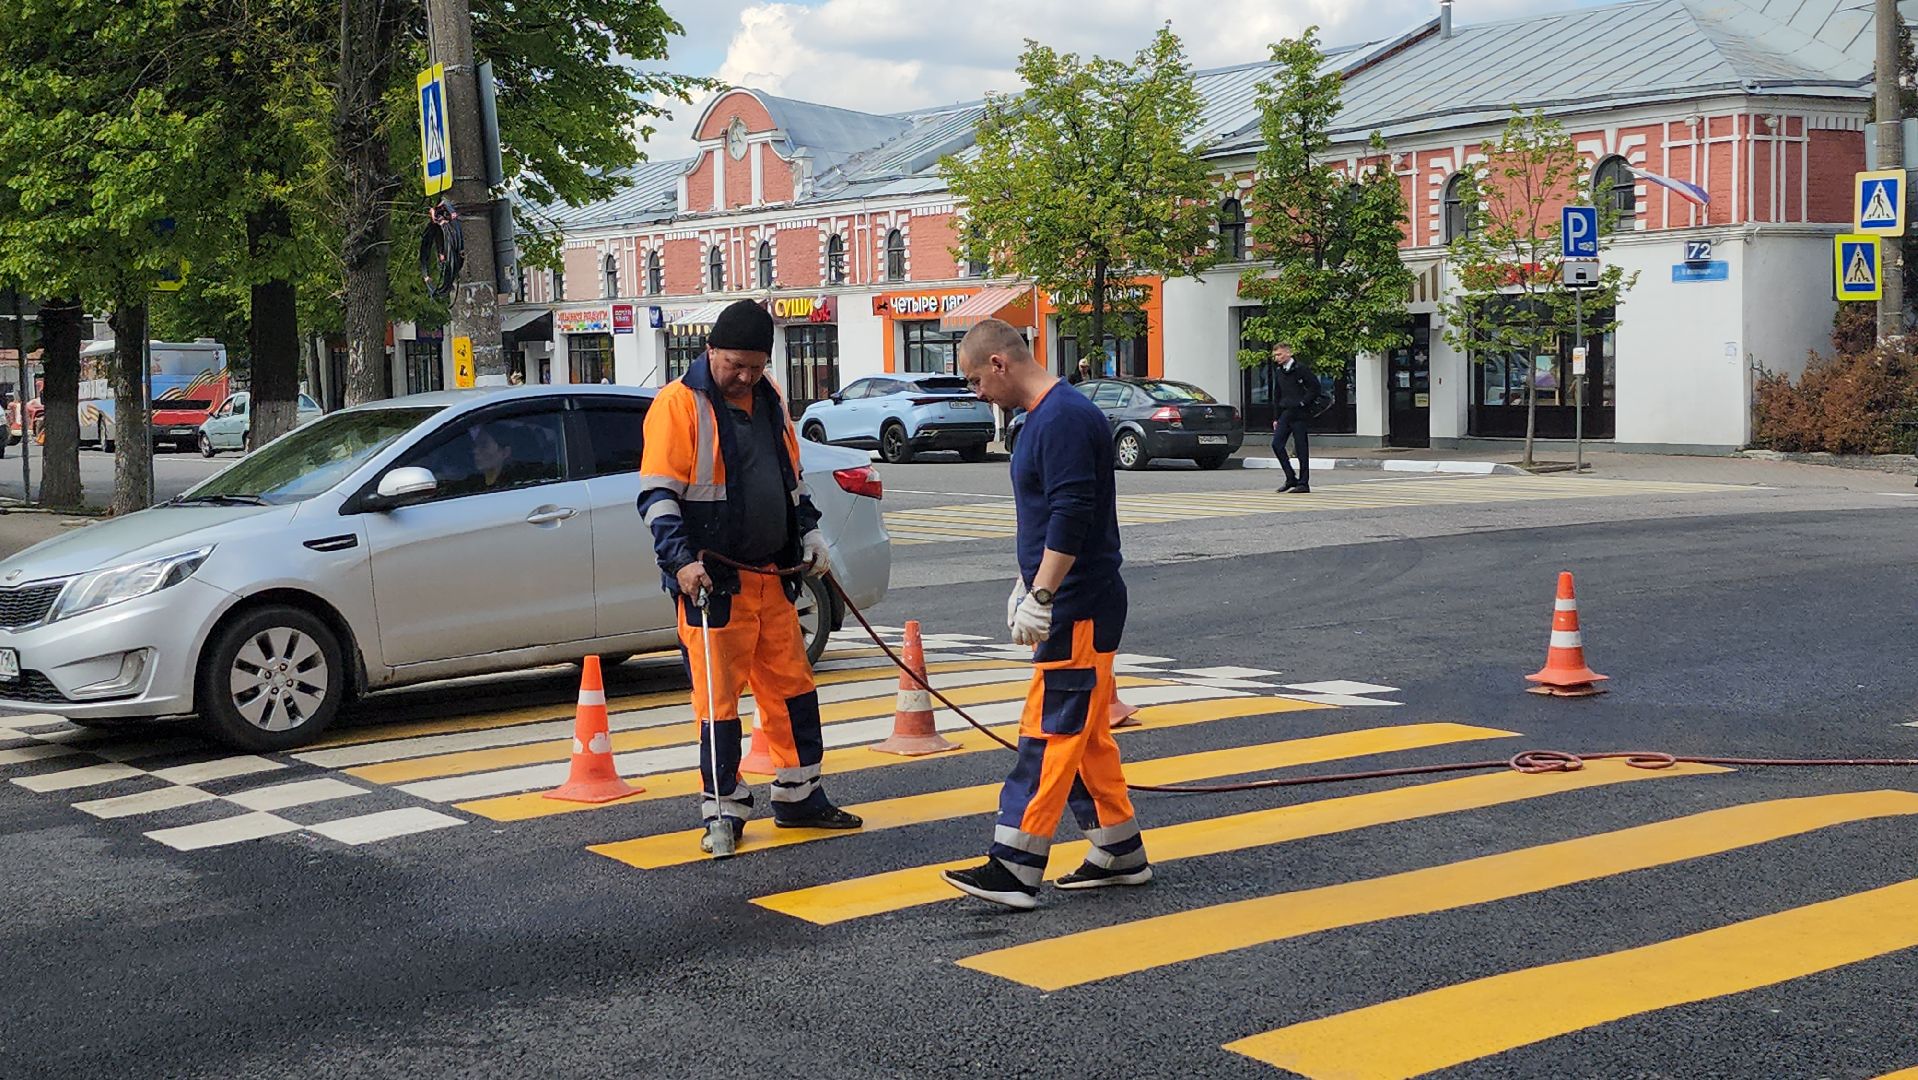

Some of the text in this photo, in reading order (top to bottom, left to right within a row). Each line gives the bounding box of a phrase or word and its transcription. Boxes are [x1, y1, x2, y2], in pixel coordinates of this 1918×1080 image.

[1567, 212, 1588, 252] P
[1688, 242, 1711, 259] 72
[775, 297, 814, 318] СУШИ
